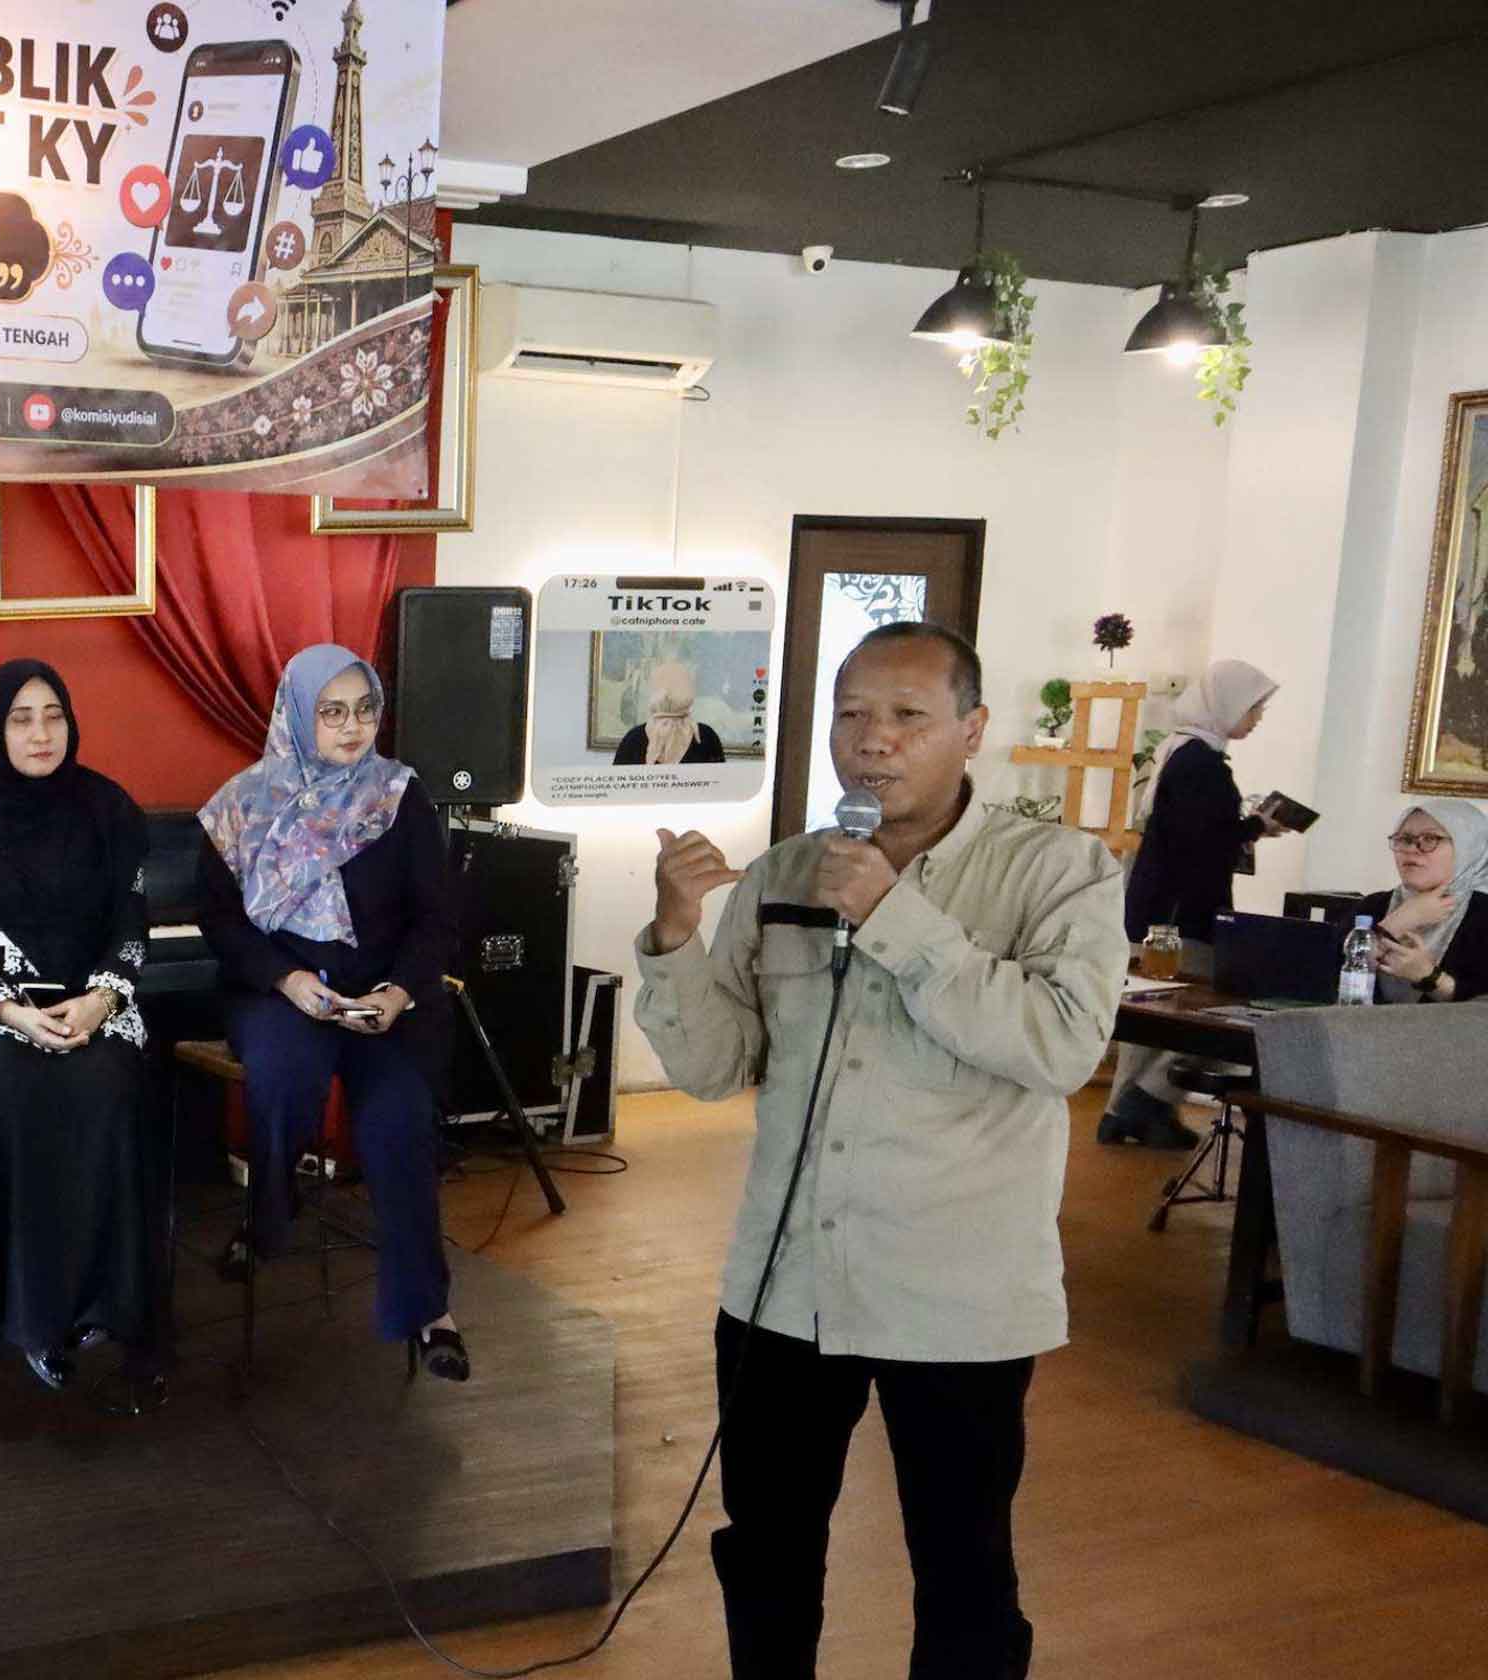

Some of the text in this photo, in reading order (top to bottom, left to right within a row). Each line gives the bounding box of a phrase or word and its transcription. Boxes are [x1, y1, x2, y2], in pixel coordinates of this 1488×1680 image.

[28, 114, 117, 185] KY
[2, 327, 70, 348] TENGAH
[61, 407, 157, 426] @komisiyudisial
[564, 578, 598, 589] 17:26
[608, 595, 711, 611] TikTok
